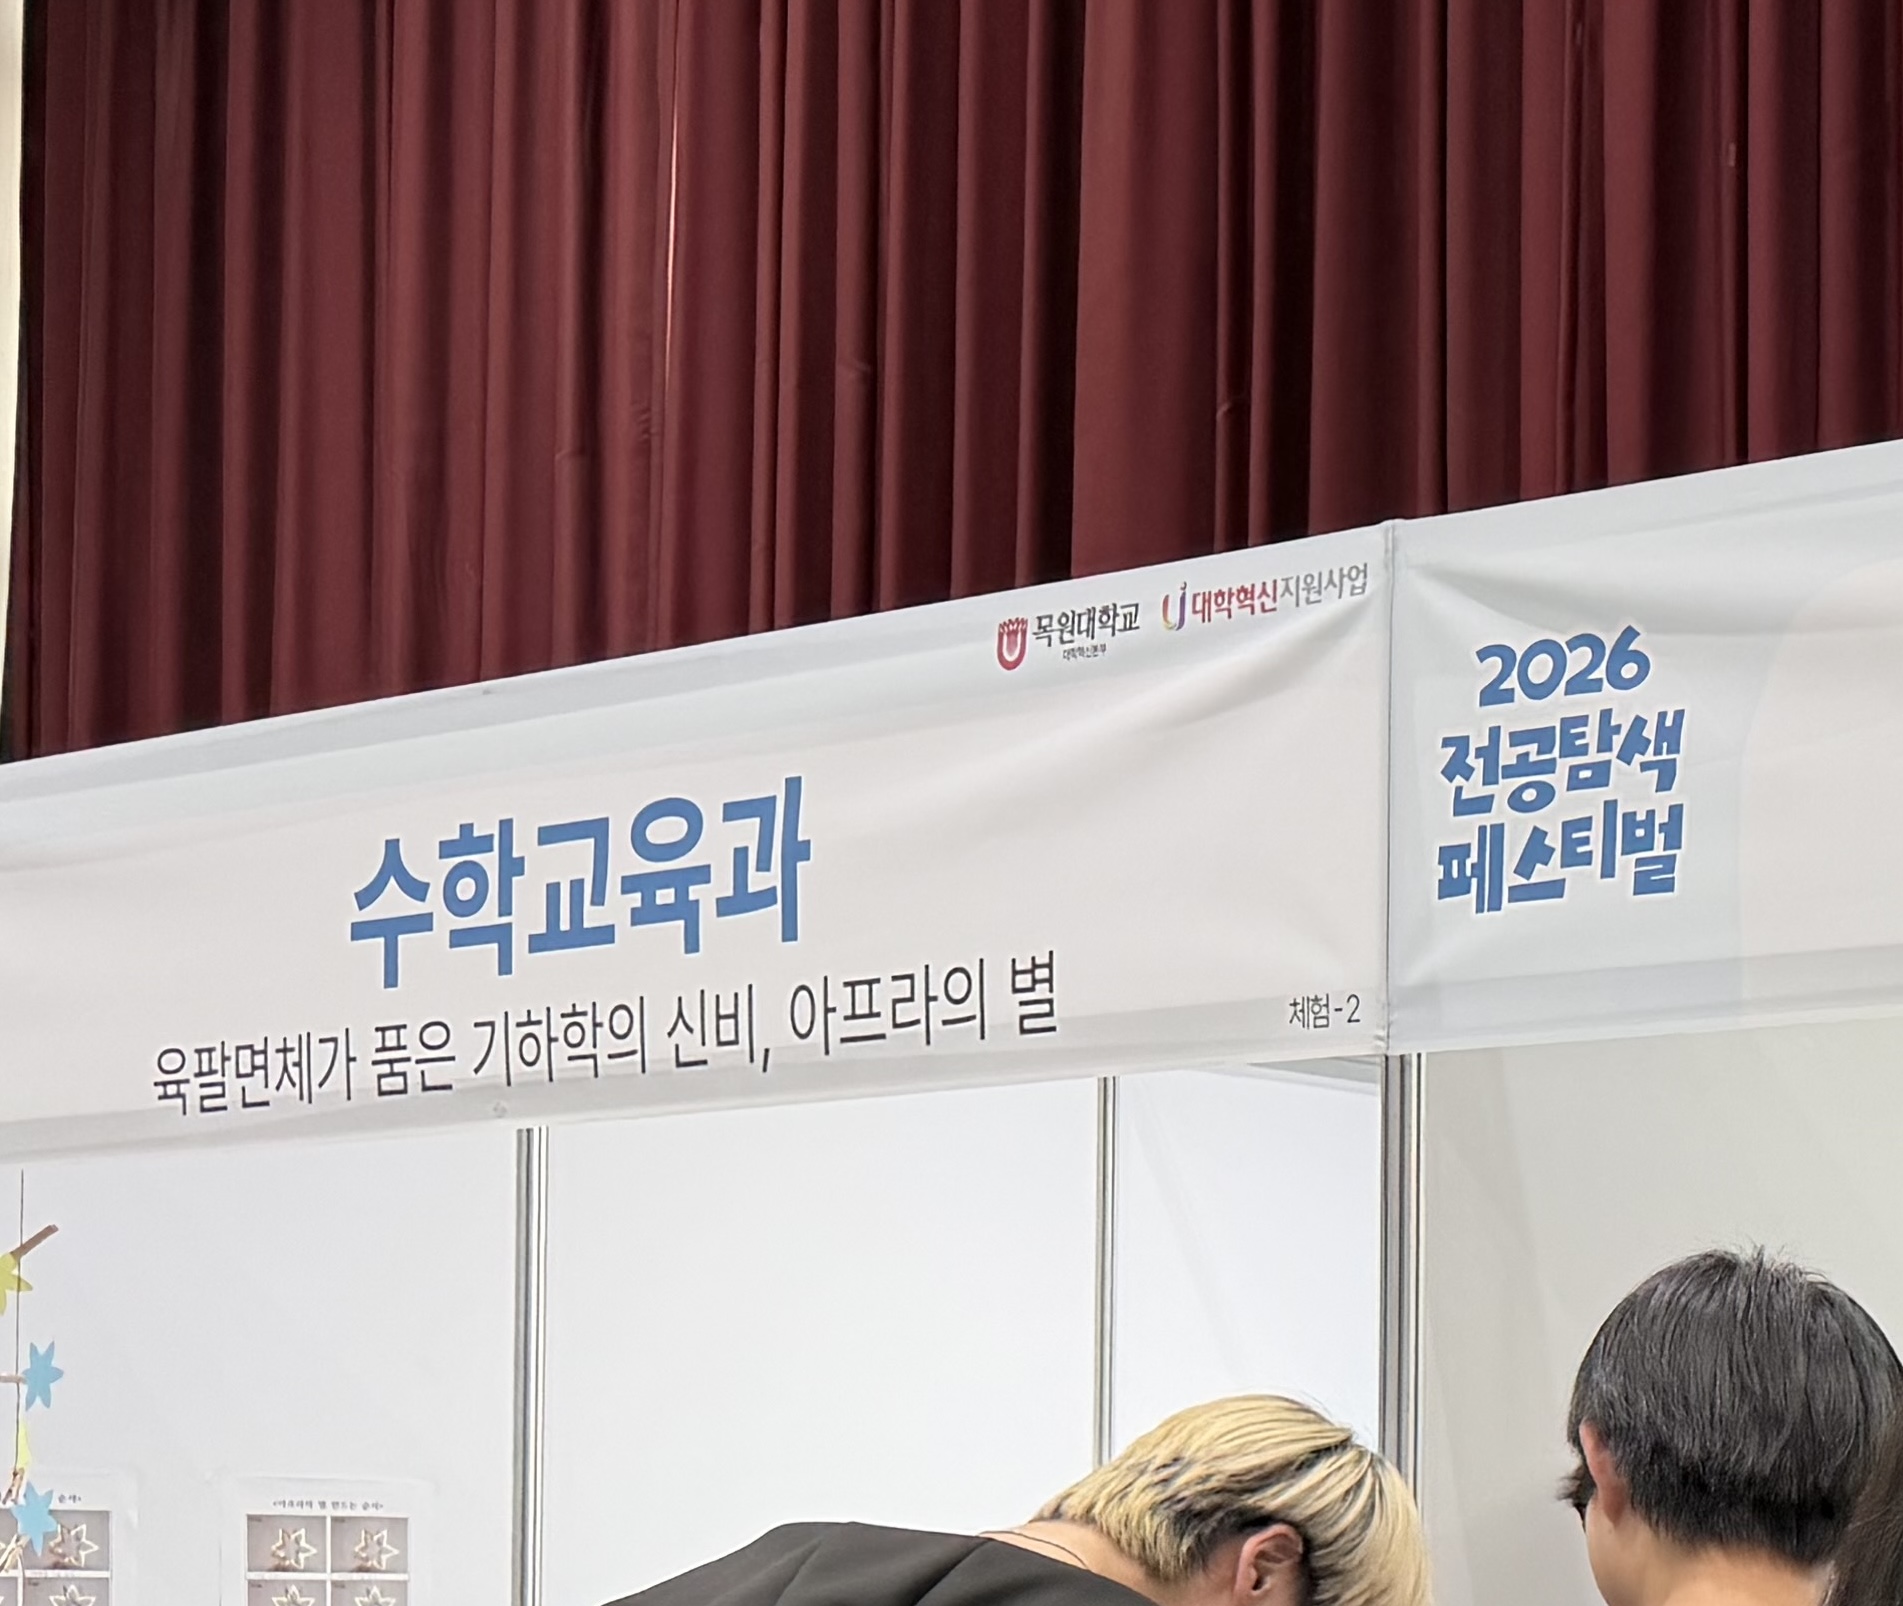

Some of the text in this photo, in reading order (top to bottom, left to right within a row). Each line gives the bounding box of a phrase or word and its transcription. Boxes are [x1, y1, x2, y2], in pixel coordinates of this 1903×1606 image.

[1032, 603, 1140, 649] 목원대학교
[1192, 563, 1368, 624] 대학혁신지원사업
[1475, 625, 1651, 707] 2026
[1440, 707, 1685, 817] 전공탐색
[350, 776, 811, 989] 수학교육과
[1438, 799, 1684, 914] 페스티벌
[153, 950, 1057, 1117] 육팔면체가 품은 기하학의 신비, 아프라의 별
